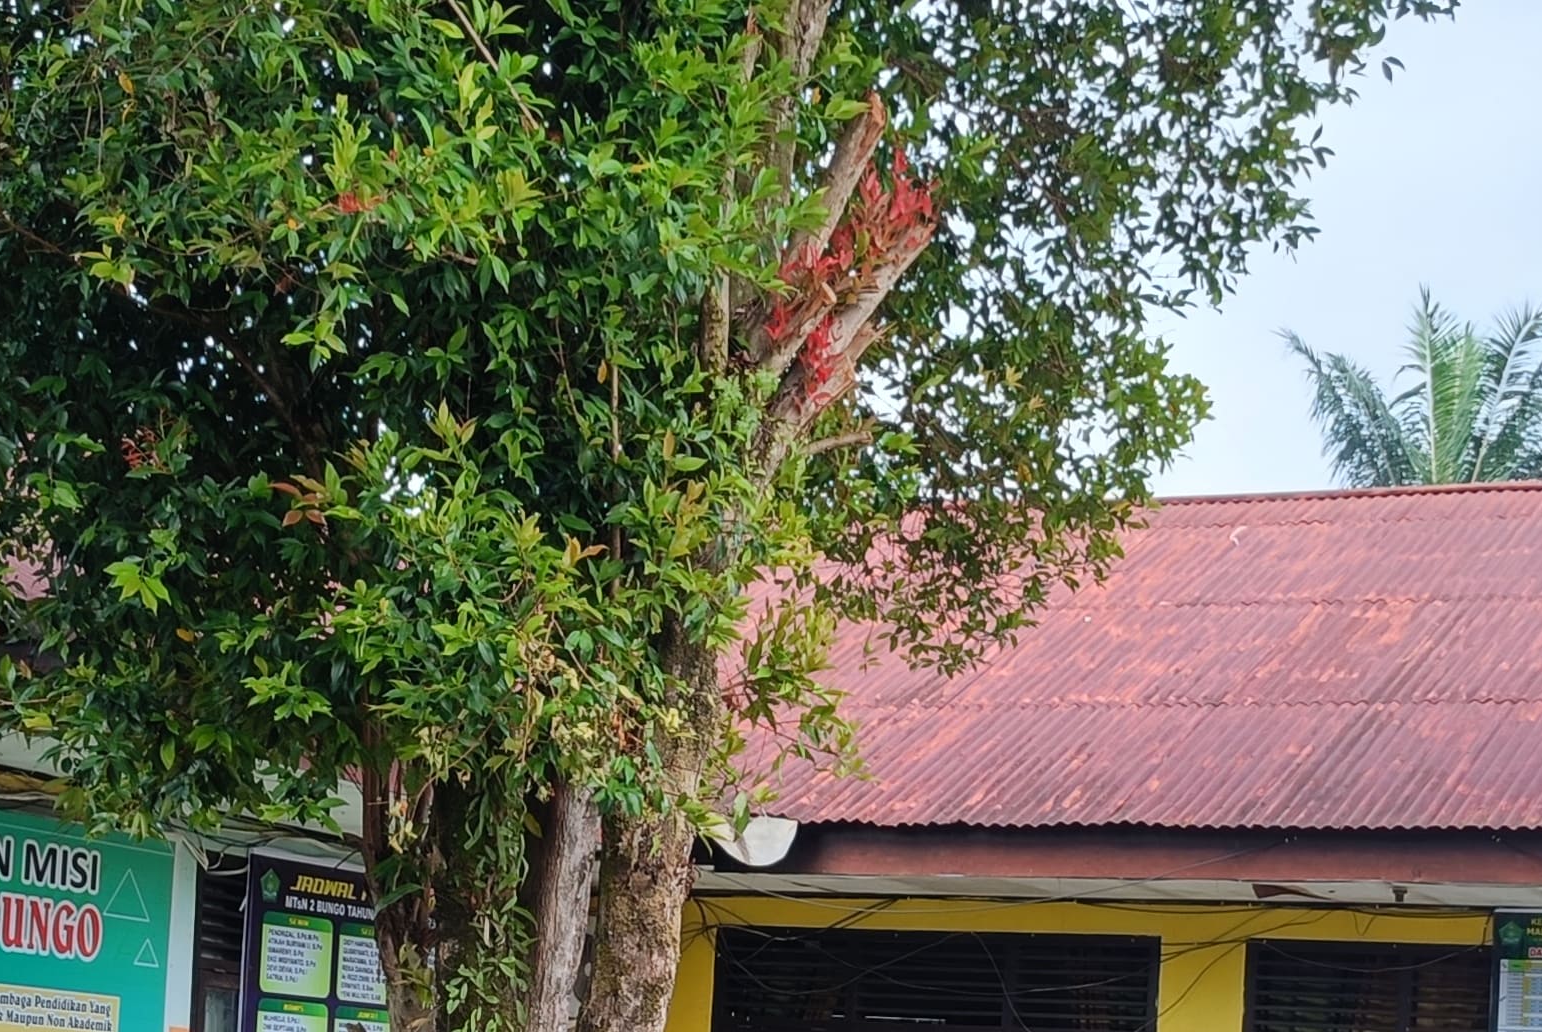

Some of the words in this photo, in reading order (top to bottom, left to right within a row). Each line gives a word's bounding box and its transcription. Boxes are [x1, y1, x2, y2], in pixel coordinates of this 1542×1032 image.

[22, 841, 101, 893] MISI
[289, 875, 357, 901] JADWAL
[285, 895, 308, 910] MTsN
[309, 899, 316, 912] 2
[316, 901, 346, 916] BUNGO
[347, 904, 375, 921] TAHUN
[34, 995, 88, 1014] Pendidikan
[90, 1000, 112, 1018] Yang
[6, 1009, 44, 1027] Maupun
[46, 1013, 66, 1028] Non
[66, 1014, 113, 1032] Akademik
